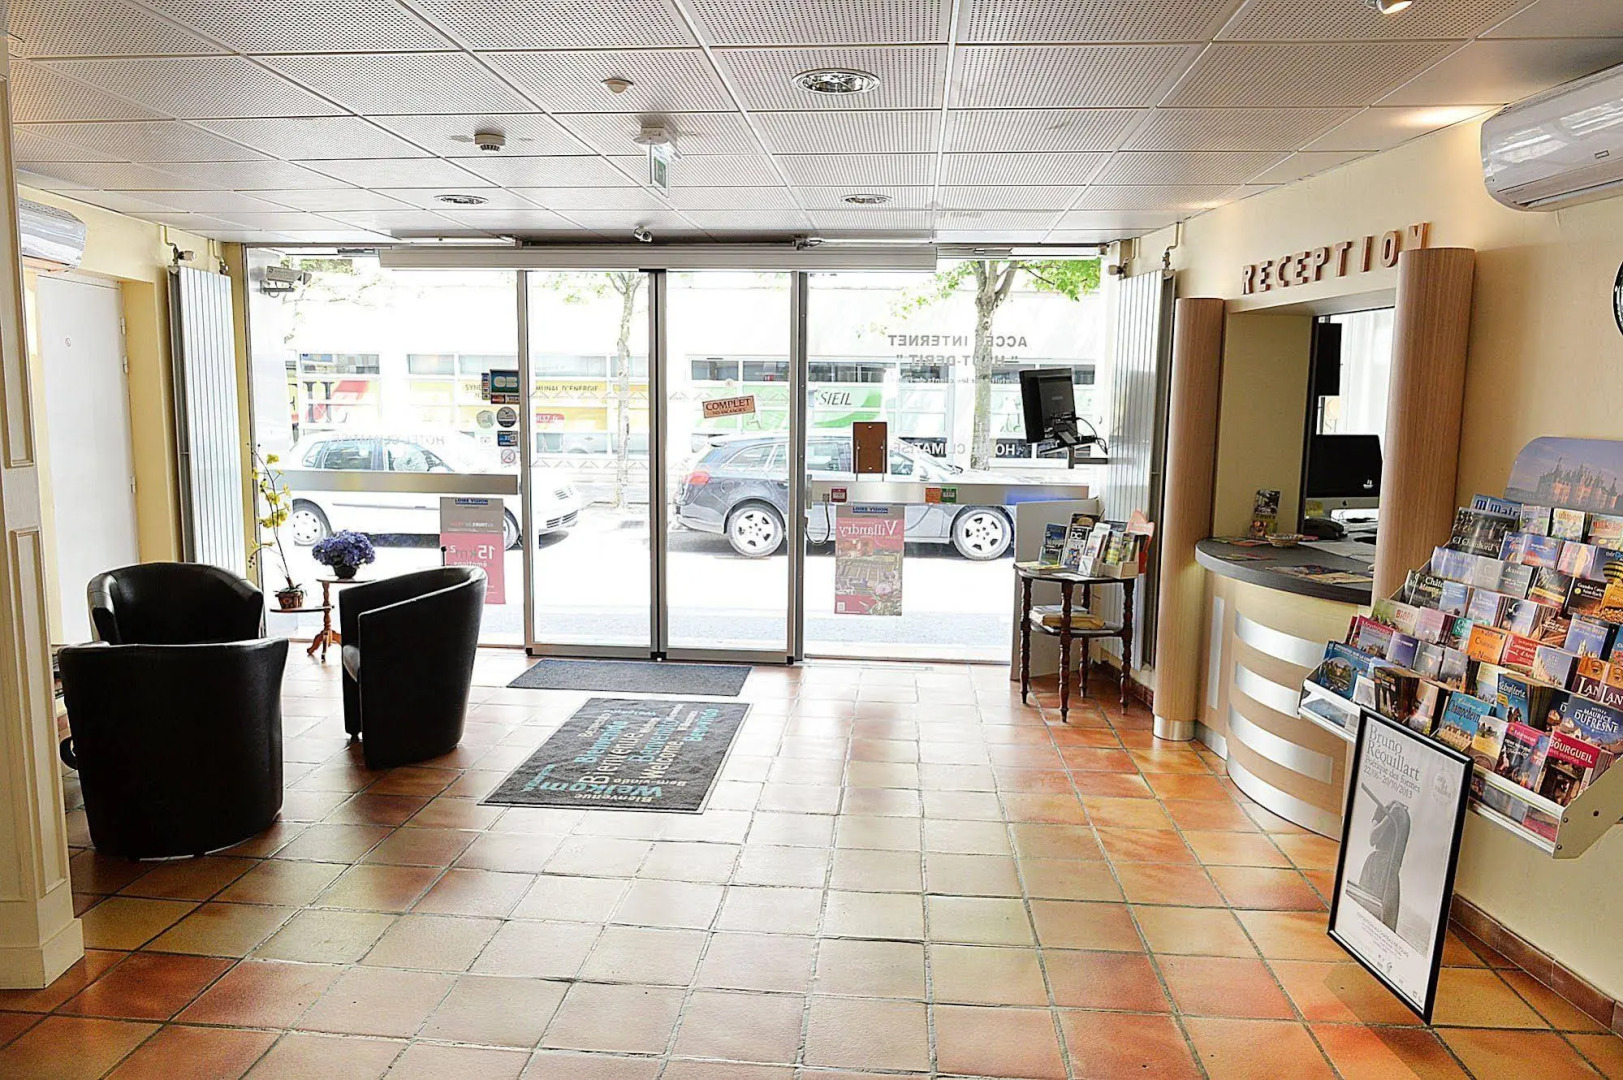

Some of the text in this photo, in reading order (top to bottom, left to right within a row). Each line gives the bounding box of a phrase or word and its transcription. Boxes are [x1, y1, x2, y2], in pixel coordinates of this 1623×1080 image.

[705, 398, 750, 411] COMPLET
[1574, 709, 1618, 733] DUFRESNE
[1583, 708, 1611, 722] MAURICE
[1369, 724, 1403, 754] Bruno
[579, 732, 644, 783] Bienvenue
[1367, 740, 1420, 781] Réquillart
[1549, 740, 1593, 764] BOURGUEIL
